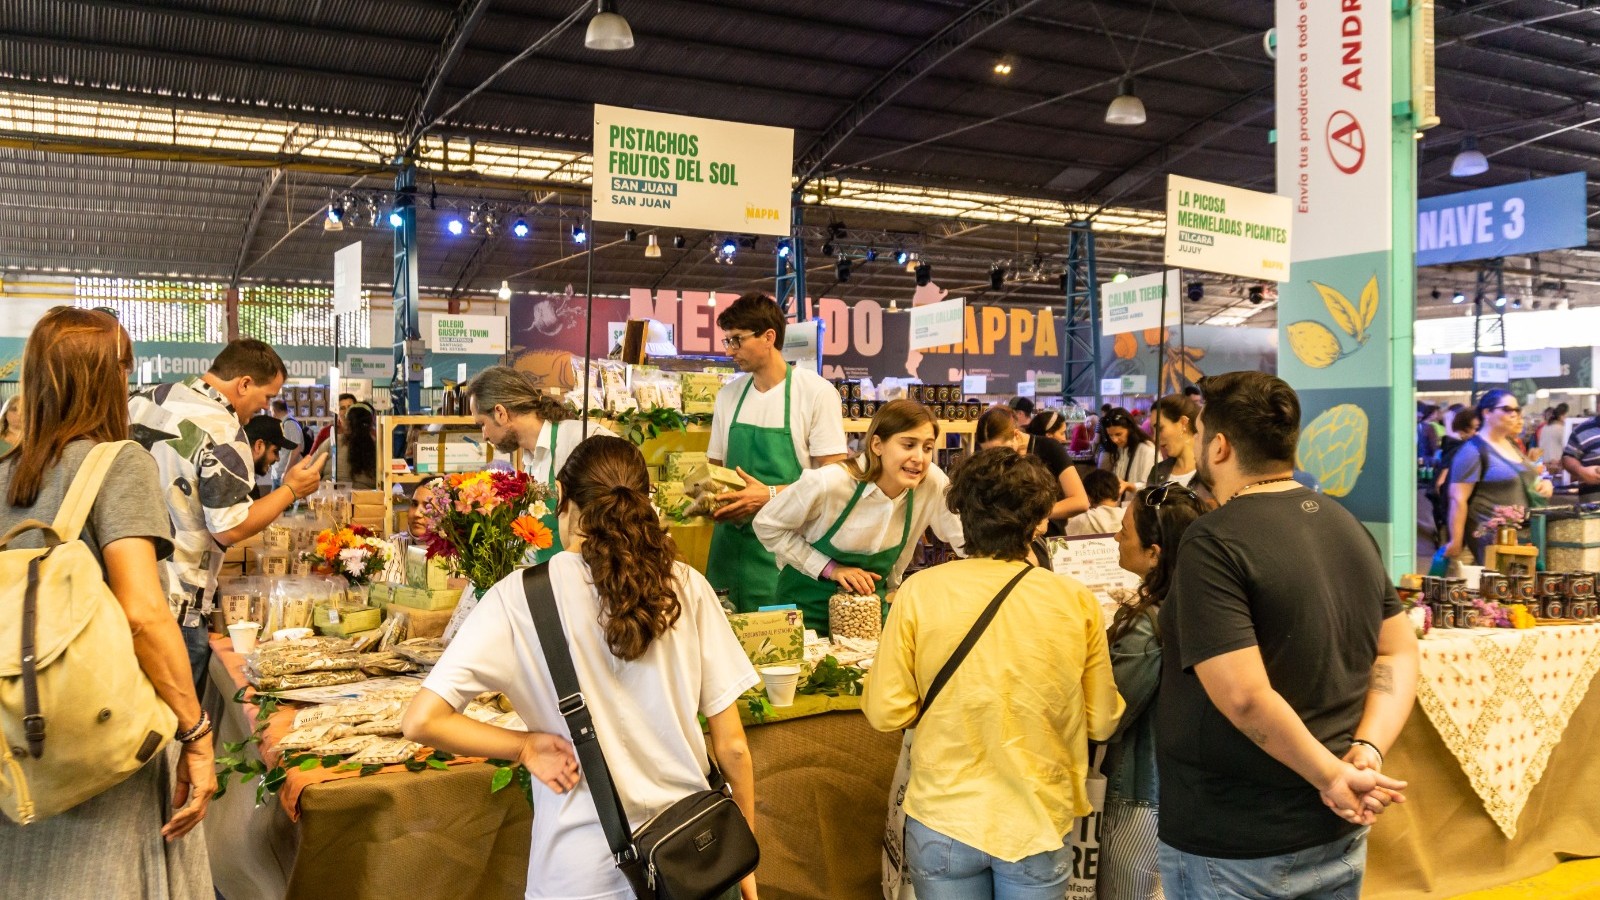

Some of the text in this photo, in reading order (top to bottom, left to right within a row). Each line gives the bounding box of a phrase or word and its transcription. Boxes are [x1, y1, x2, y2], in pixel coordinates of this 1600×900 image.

[1297, 0, 1308, 10] e
[1297, 14, 1308, 49] todo
[1300, 53, 1308, 62] a
[1297, 66, 1310, 142] productos
[610, 125, 699, 157] PISTACHOS
[1298, 145, 1308, 169] tus
[609, 151, 739, 186] FRUTOS DEL SOL
[613, 178, 673, 195] SAN JUAN
[612, 195, 671, 209] SAN JUAN
[1179, 190, 1226, 214] LA PICOSA
[746, 206, 779, 220] MAPPA
[1178, 210, 1287, 244] MERMELADAS PICANTES
[1419, 198, 1525, 251] NAVE 3
[1180, 232, 1213, 245] TILCARA
[1179, 244, 1202, 254] JUJUY
[1108, 290, 1137, 308] CALMA
[438, 320, 464, 328] COLEGIO
[438, 329, 468, 337] GIUSEPPE
[918, 305, 1058, 356] APPA
